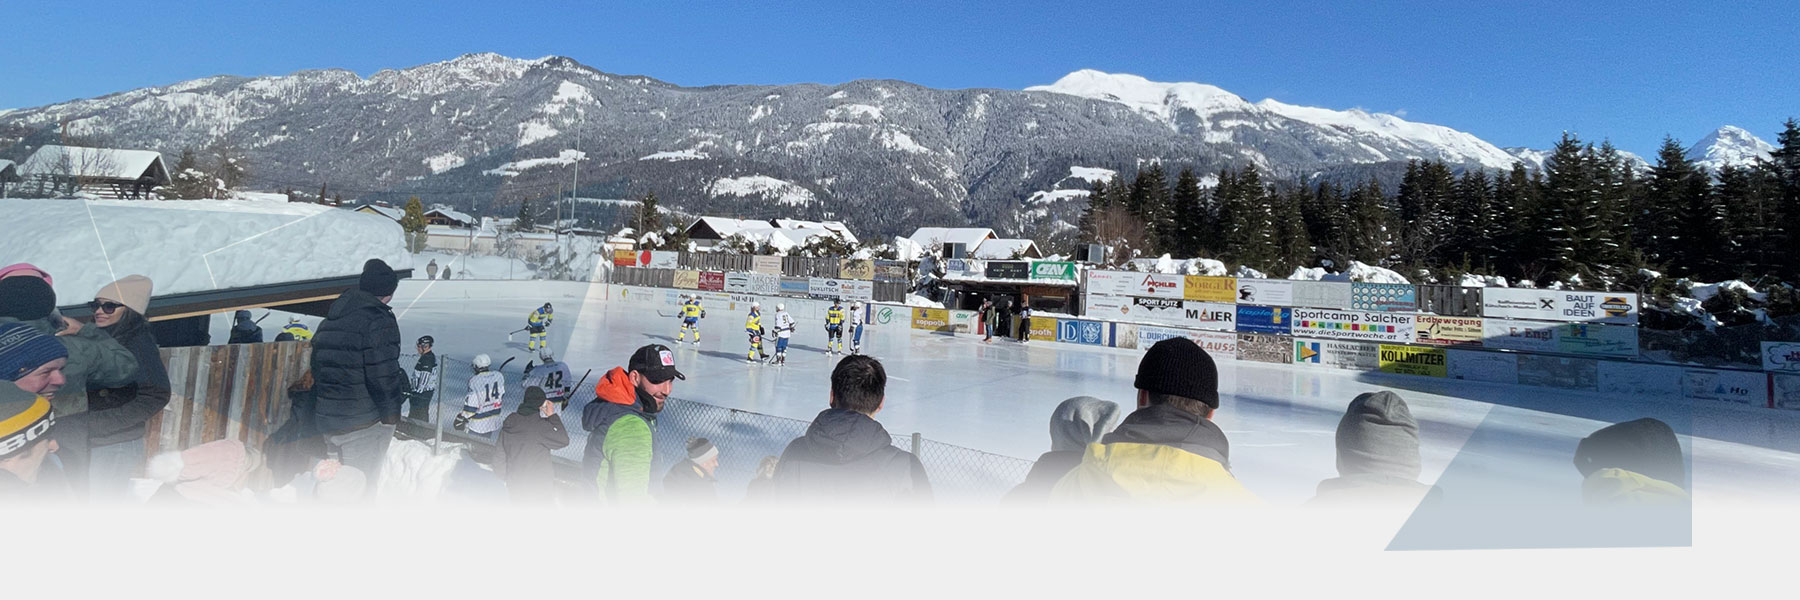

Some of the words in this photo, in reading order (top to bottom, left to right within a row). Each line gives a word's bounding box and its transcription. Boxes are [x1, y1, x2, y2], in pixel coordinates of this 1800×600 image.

[1161, 299, 1178, 307] PUTZ
[1566, 295, 1595, 303] BAUT
[1294, 309, 1359, 322] Sportcamp
[1364, 312, 1411, 324] Salcher
[1563, 308, 1595, 317] IDEEN
[1416, 315, 1482, 327] Erdbewegung
[1293, 328, 1398, 340] www.dieSportwoche.at
[1381, 350, 1445, 366] KOLLMITZER
[545, 370, 563, 389] 42
[484, 381, 500, 402] 14
